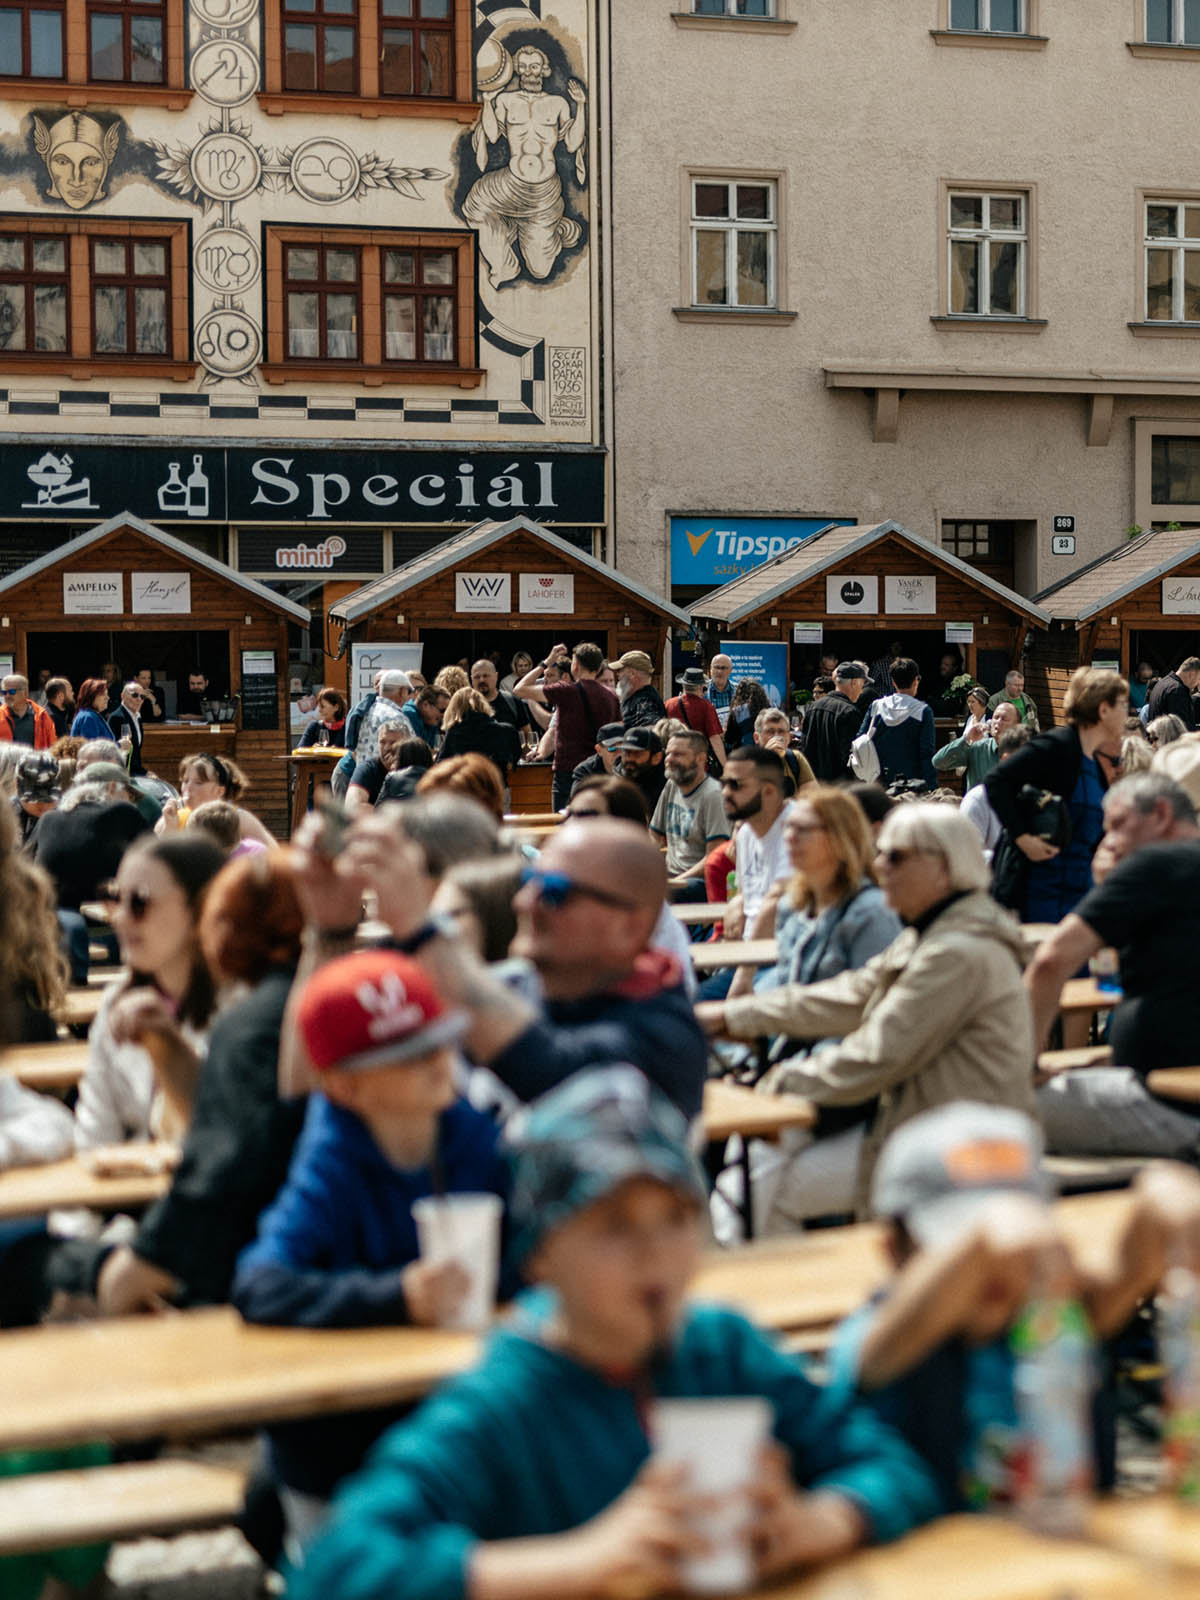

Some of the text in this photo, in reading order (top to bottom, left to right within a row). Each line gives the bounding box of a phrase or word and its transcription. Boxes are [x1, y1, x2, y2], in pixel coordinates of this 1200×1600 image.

[553, 381, 581, 394] 1936
[250, 457, 560, 518] Speciál
[1056, 517, 1072, 528] 269
[1058, 538, 1069, 548] 23
[67, 583, 118, 592] AMPELOS
